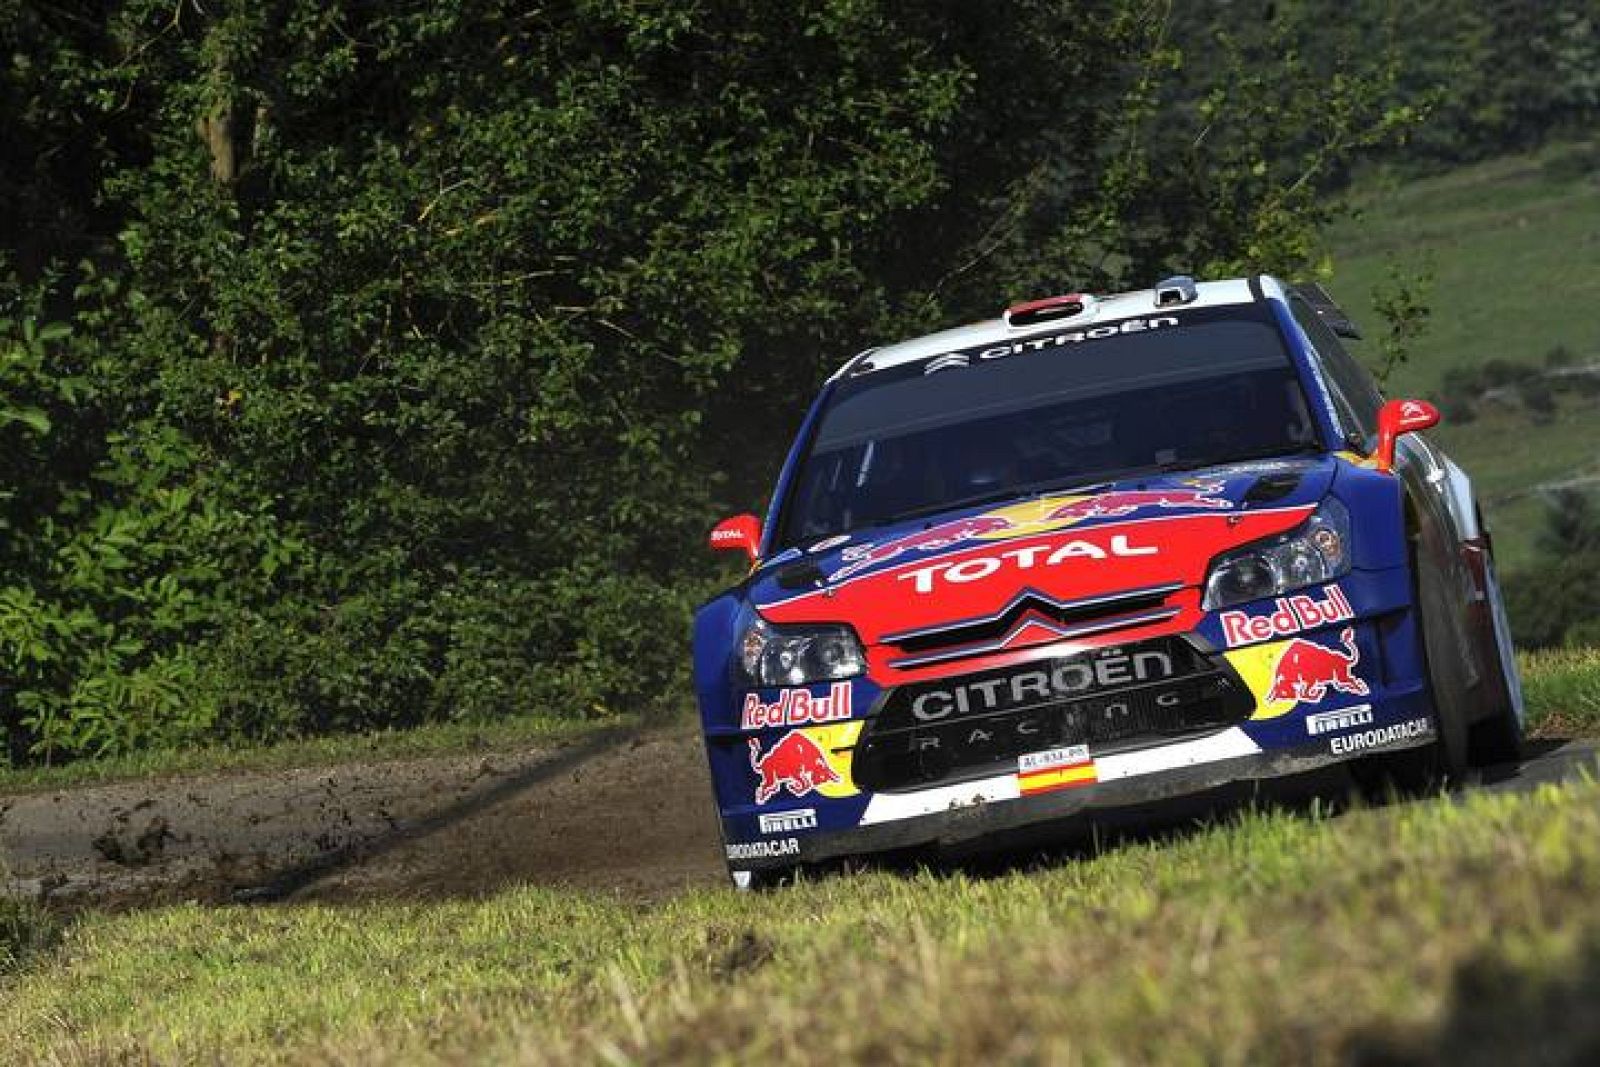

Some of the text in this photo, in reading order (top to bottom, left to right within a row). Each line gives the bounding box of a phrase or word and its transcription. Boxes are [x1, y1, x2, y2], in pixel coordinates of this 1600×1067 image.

[897, 535, 1160, 593] TOTAL
[1220, 584, 1354, 647] Red Bull
[742, 681, 852, 729] Red Bull
[1306, 704, 1373, 736] PIRELLI
